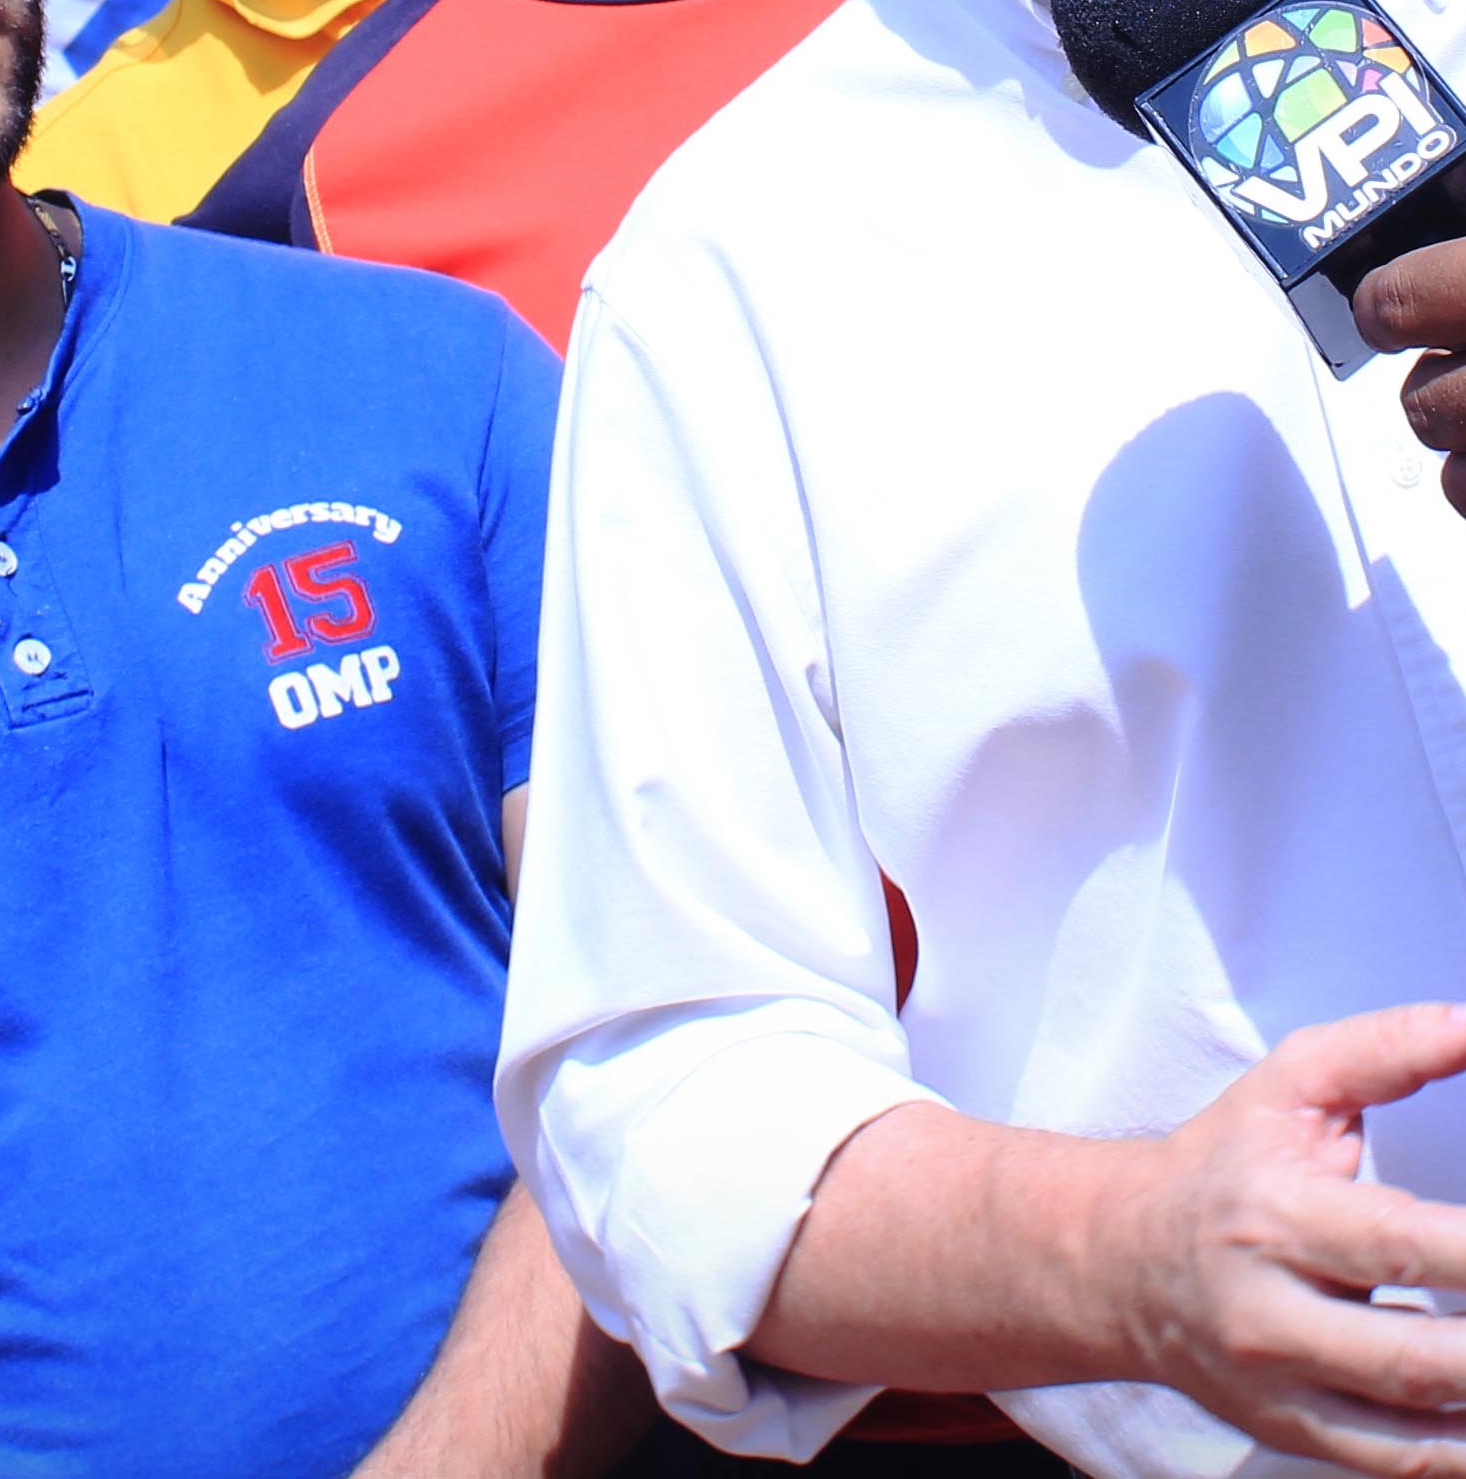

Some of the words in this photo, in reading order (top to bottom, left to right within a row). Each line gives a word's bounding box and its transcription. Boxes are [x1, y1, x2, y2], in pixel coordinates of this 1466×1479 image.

[1231, 72, 1440, 221] VPI
[1302, 130, 1450, 248] MUNDO
[176, 500, 403, 615] Anniversary
[243, 540, 377, 664] 15
[268, 645, 400, 730] OMP
